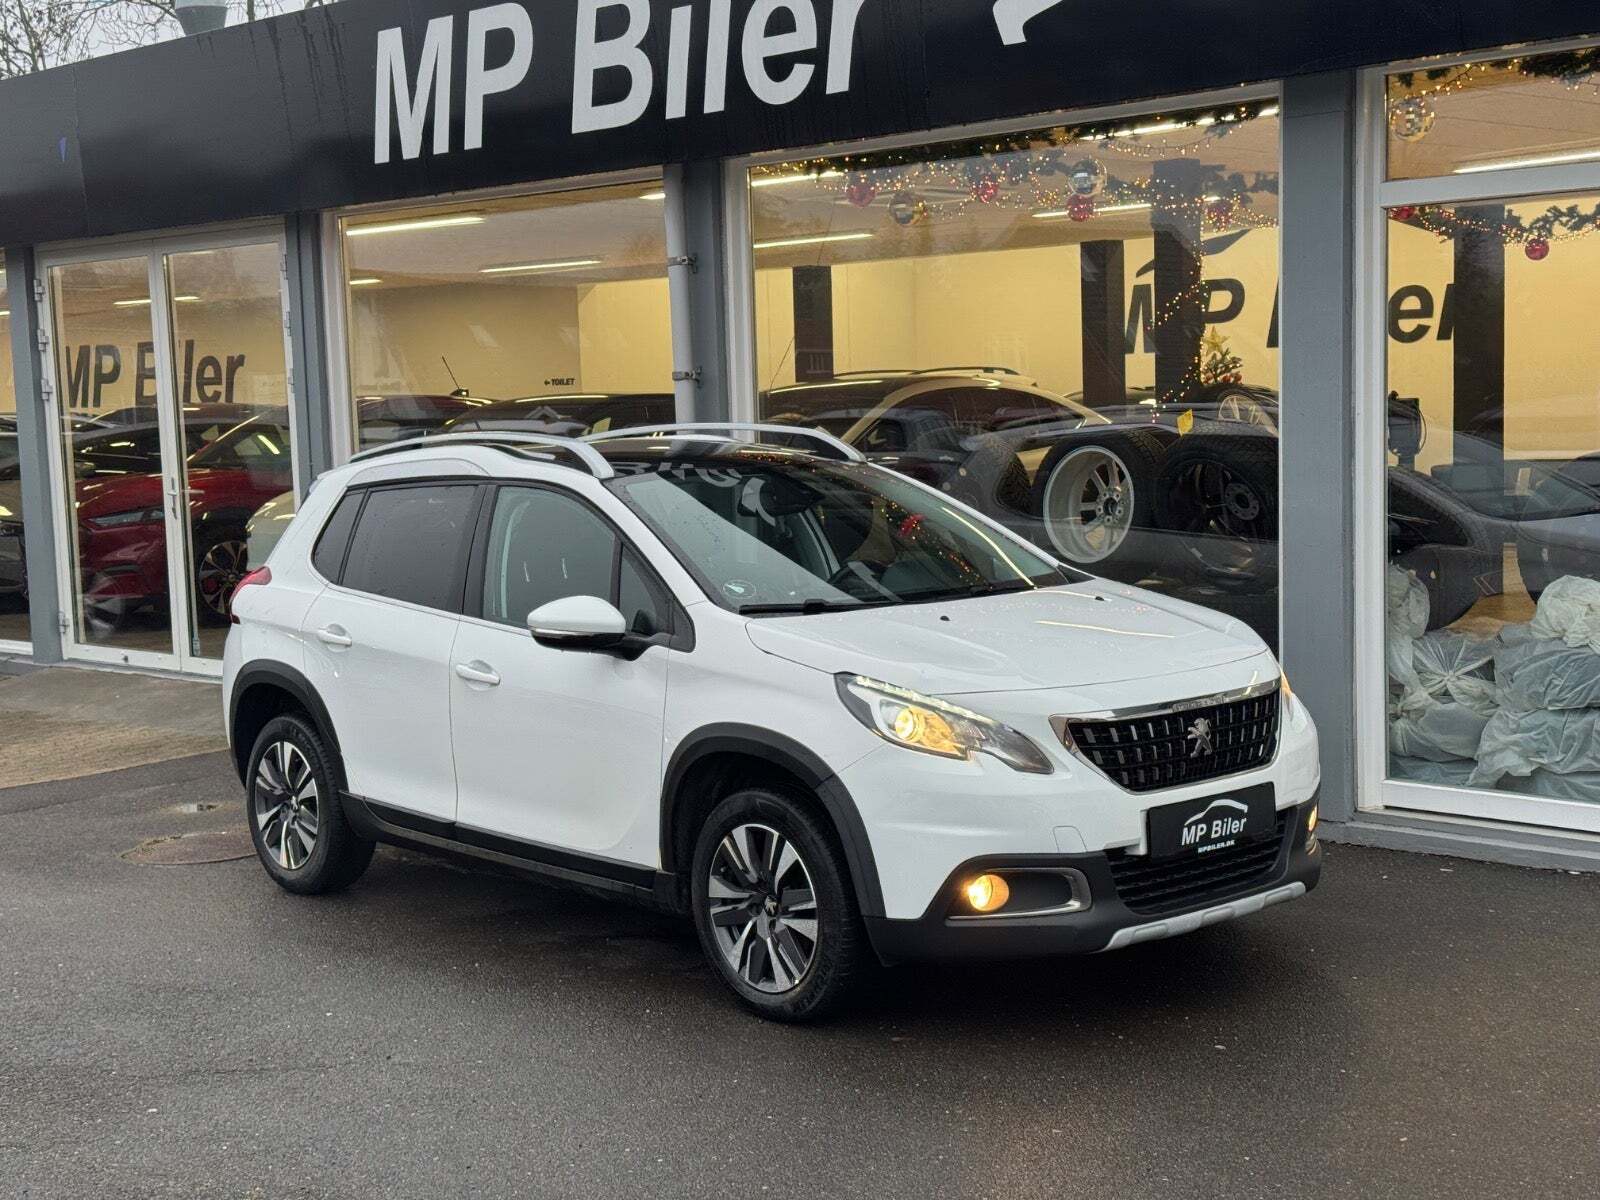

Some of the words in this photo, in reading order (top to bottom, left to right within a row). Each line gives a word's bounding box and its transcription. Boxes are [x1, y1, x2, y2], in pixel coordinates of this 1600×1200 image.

[374, 2, 534, 164] MP
[571, 0, 866, 134] Biler
[135, 339, 246, 406] Bler
[551, 378, 576, 386] TOILET
[1181, 823, 1207, 846] MP
[1211, 816, 1247, 838] Biler
